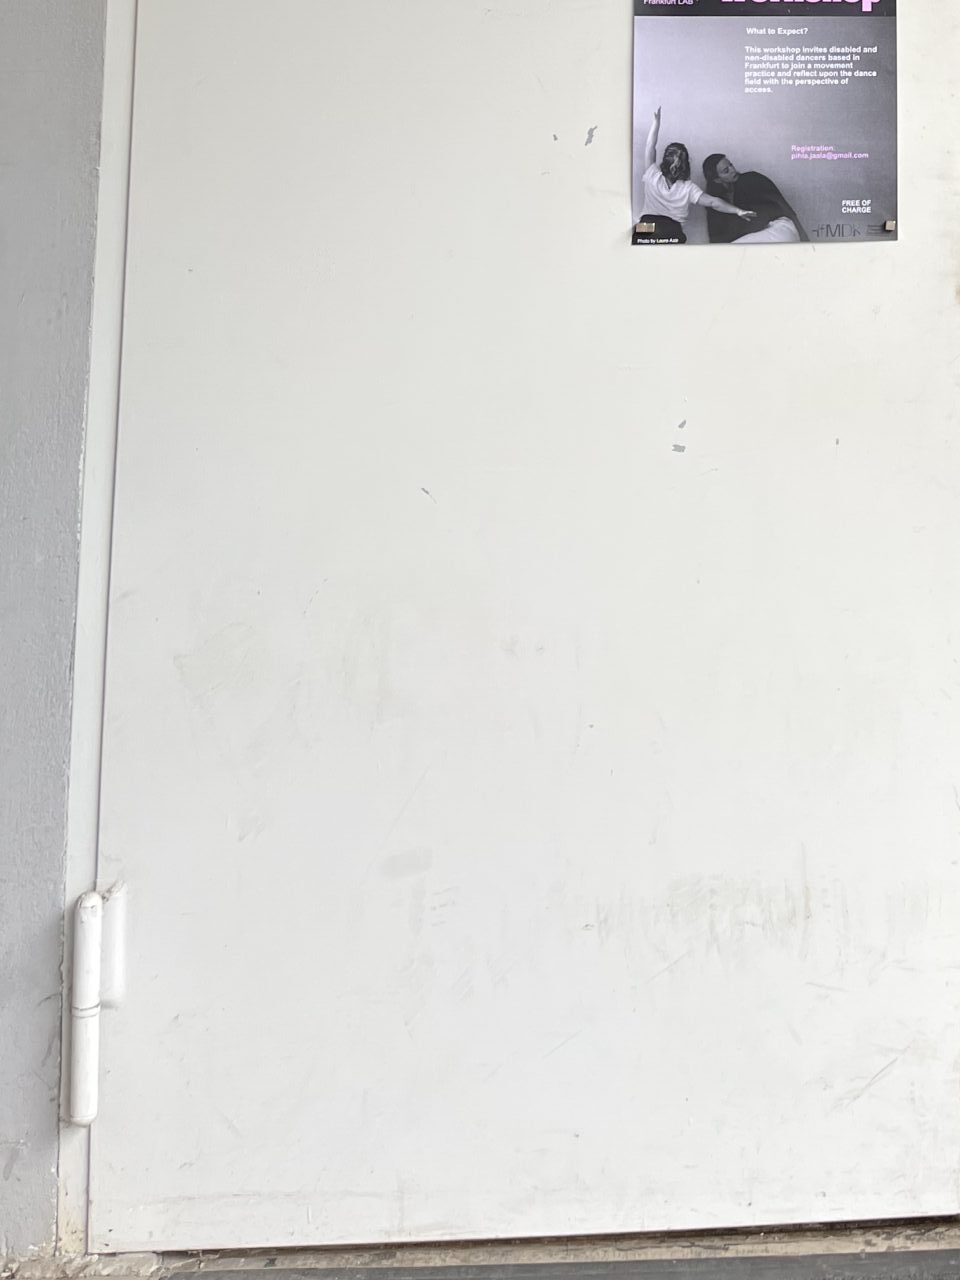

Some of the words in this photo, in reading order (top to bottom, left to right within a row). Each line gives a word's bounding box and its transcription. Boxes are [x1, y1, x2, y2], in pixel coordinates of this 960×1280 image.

[745, 27, 766, 35] What
[777, 27, 809, 36] Expect?
[763, 46, 801, 55] workshop
[829, 45, 862, 53] disabled
[863, 45, 878, 53] and
[790, 62, 805, 71] join
[744, 70, 775, 78] practice
[795, 78, 839, 86] perspective
[841, 199, 860, 207] FREE
[861, 199, 872, 207] OF
[841, 206, 872, 214] CHARGE
